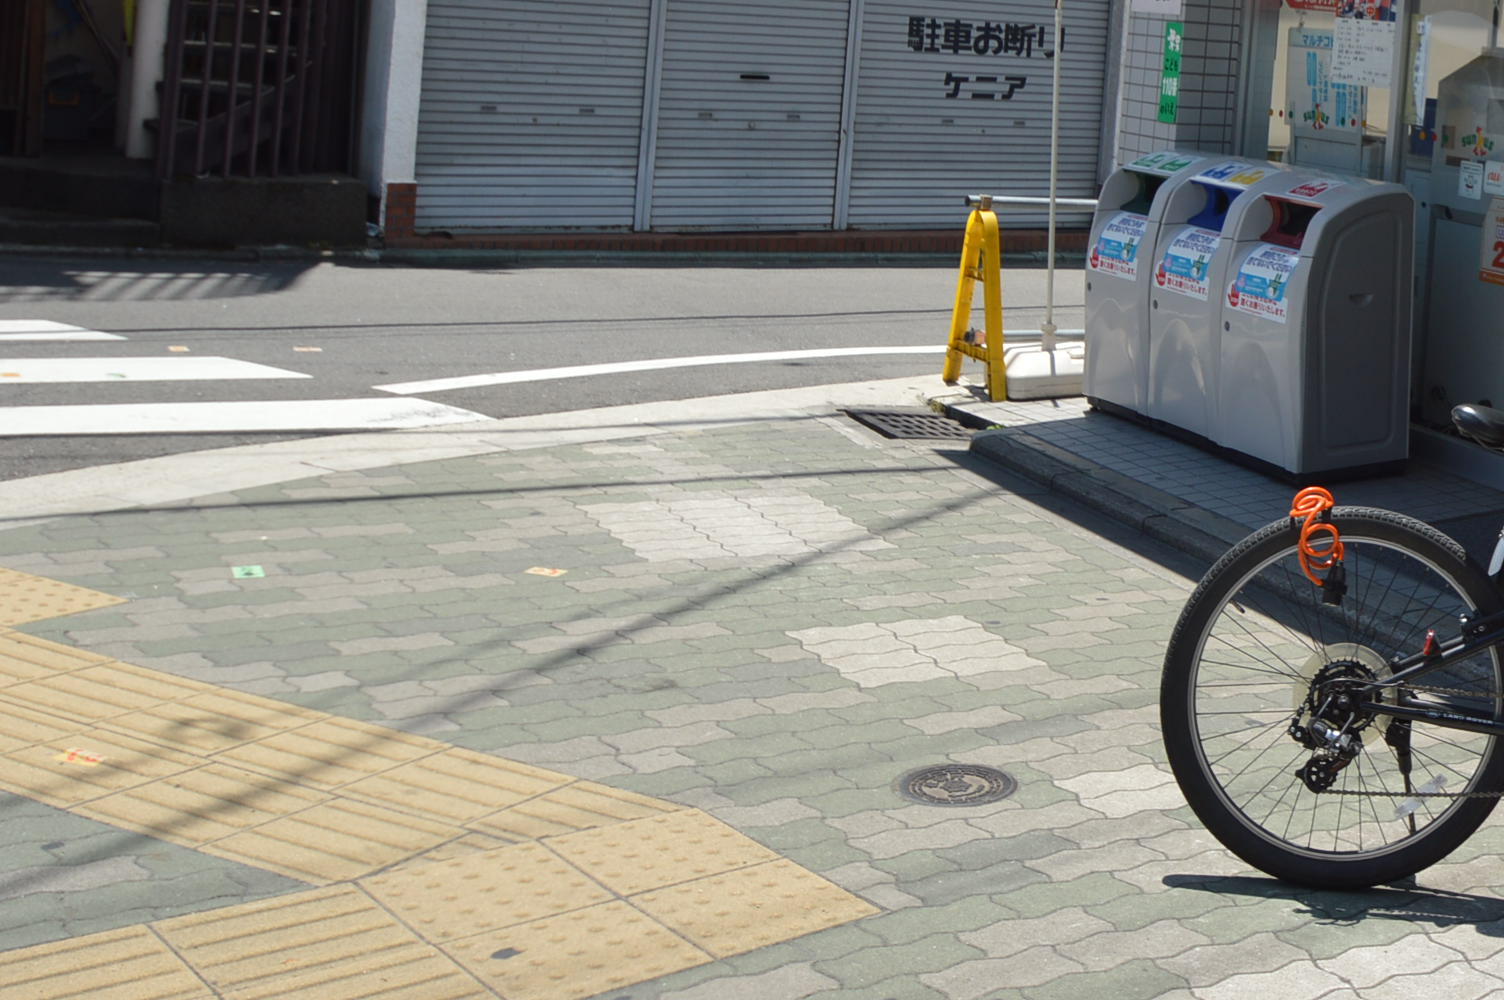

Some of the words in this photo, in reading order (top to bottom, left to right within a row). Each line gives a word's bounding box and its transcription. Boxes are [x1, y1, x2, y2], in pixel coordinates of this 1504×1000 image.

[907, 14, 1067, 59] 駐車お断り
[1302, 34, 1333, 48] マルチコ
[943, 71, 1028, 101] ケニア
